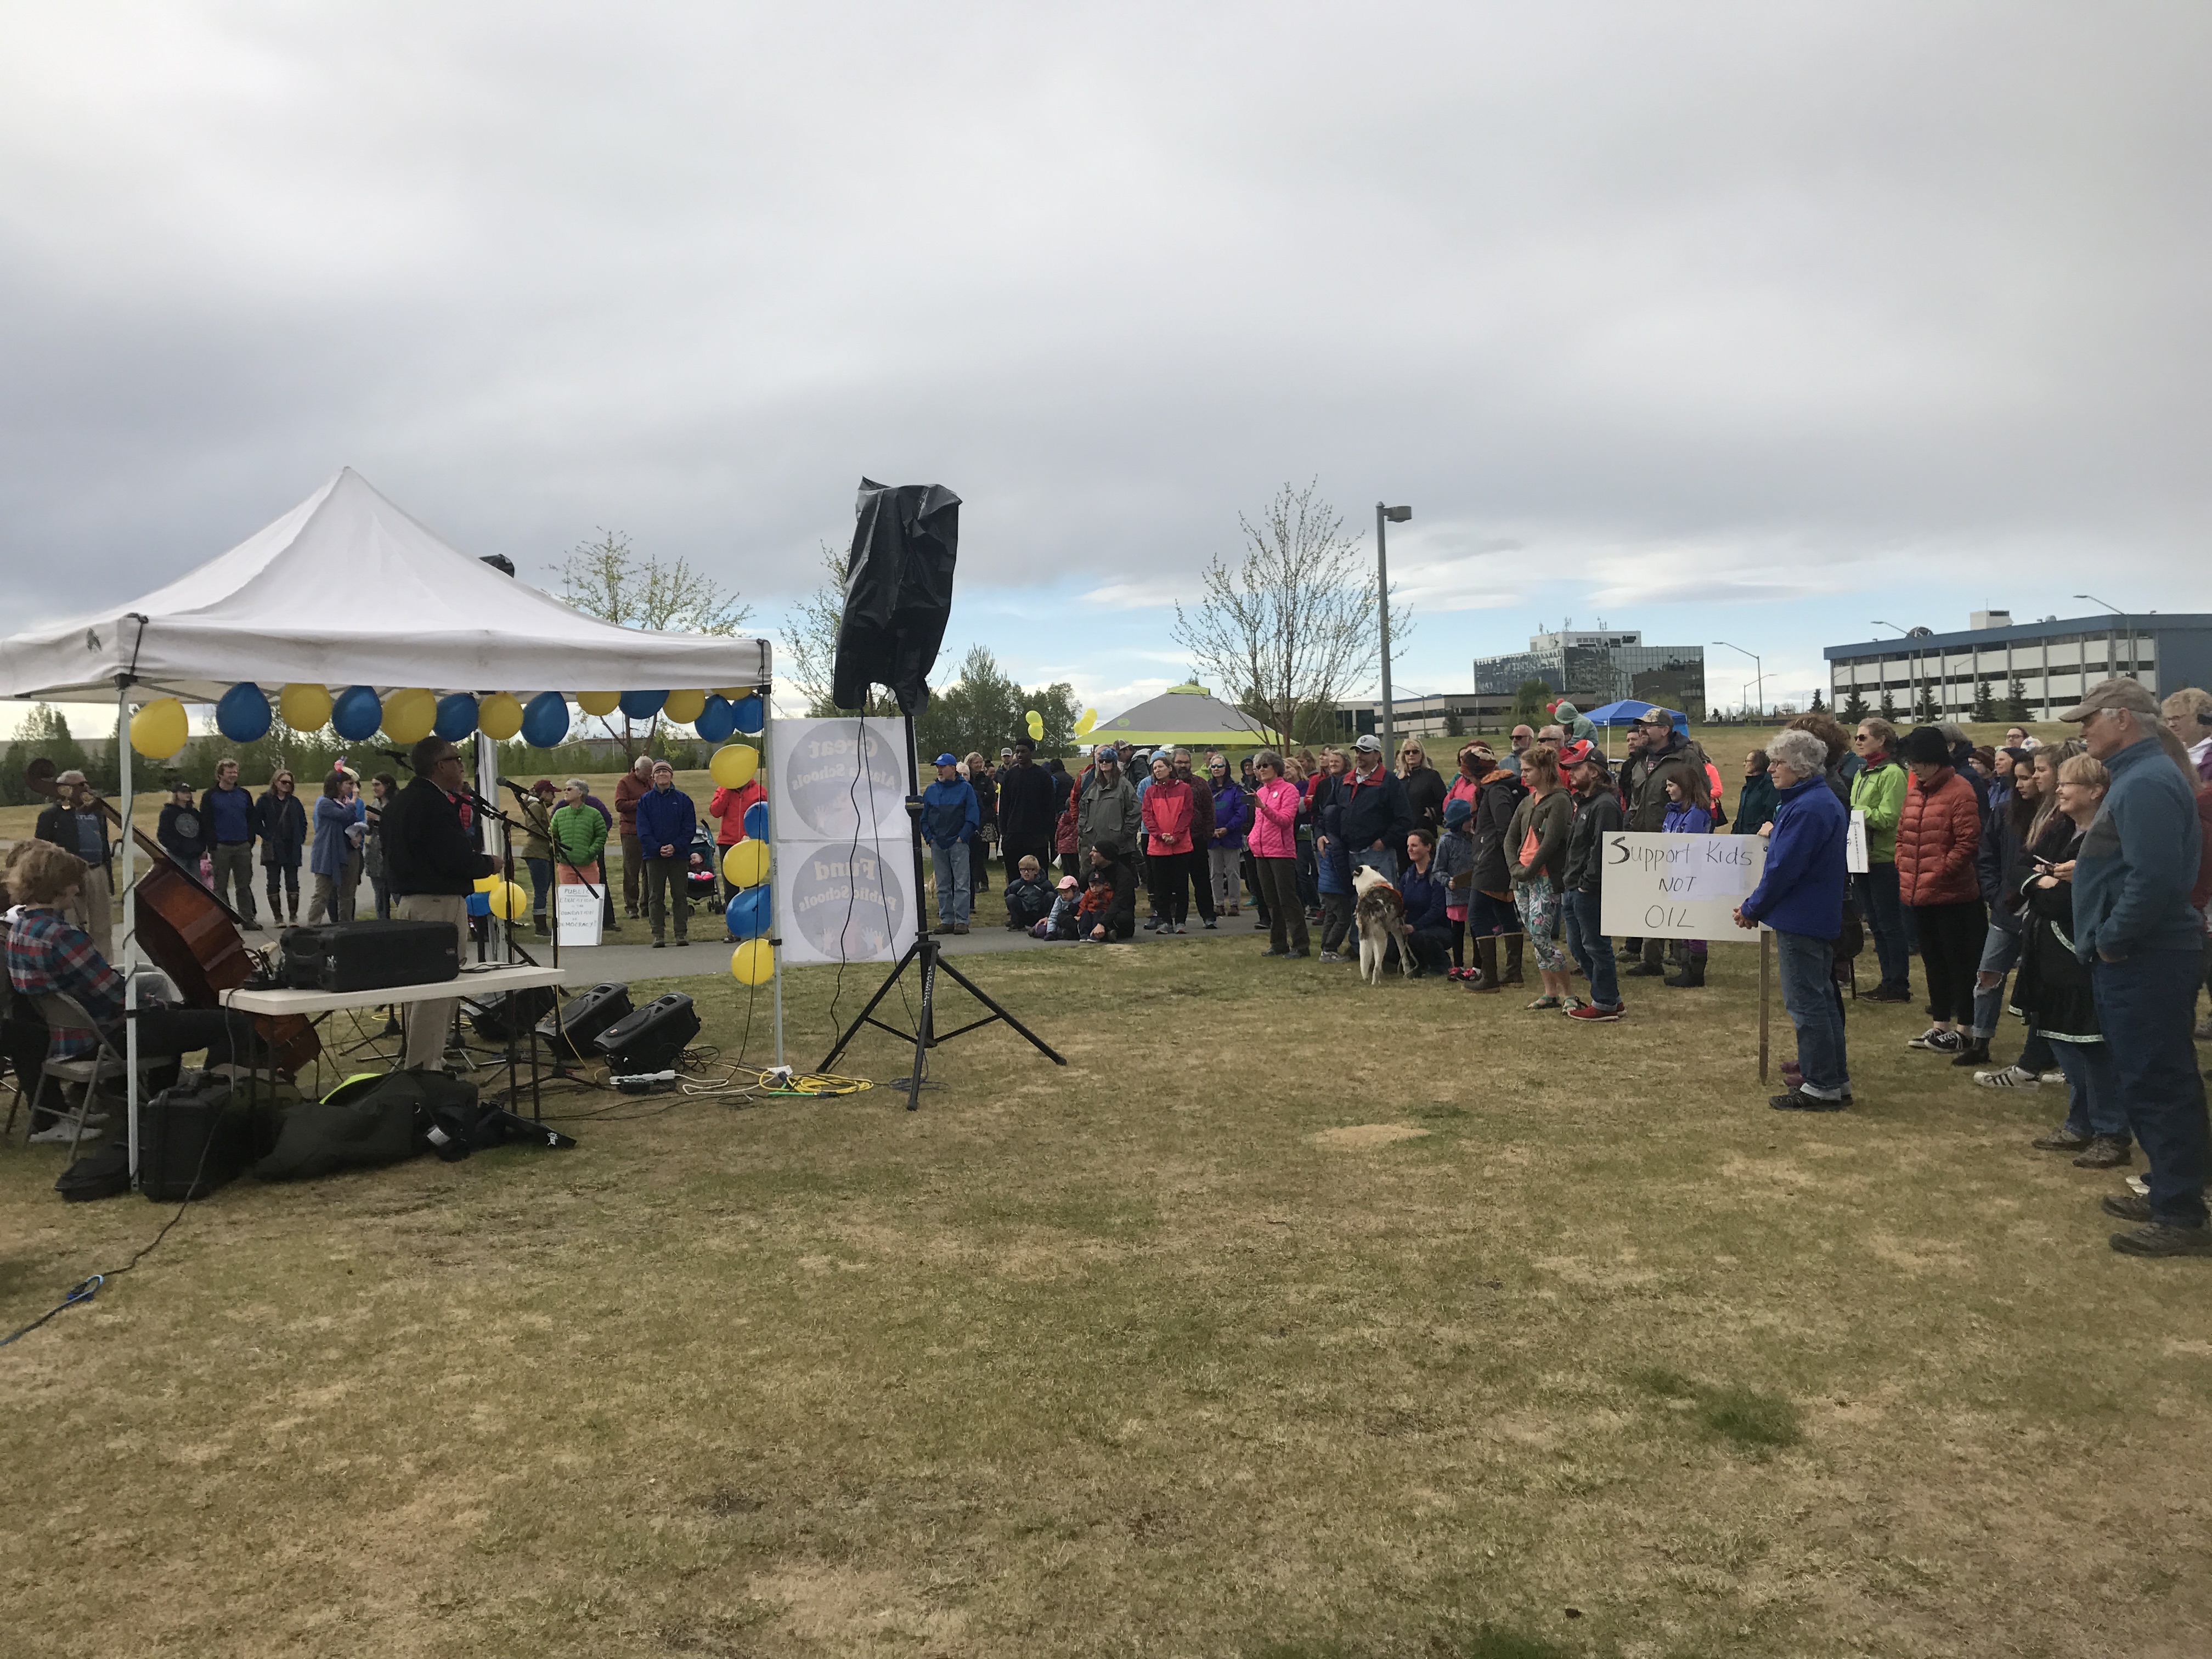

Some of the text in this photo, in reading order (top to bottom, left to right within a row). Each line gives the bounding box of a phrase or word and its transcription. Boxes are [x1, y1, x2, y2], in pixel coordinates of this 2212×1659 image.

[1609, 836, 1752, 871] Support Kids
[1658, 876, 1696, 893] NOT
[1645, 905, 1695, 928] OIL
